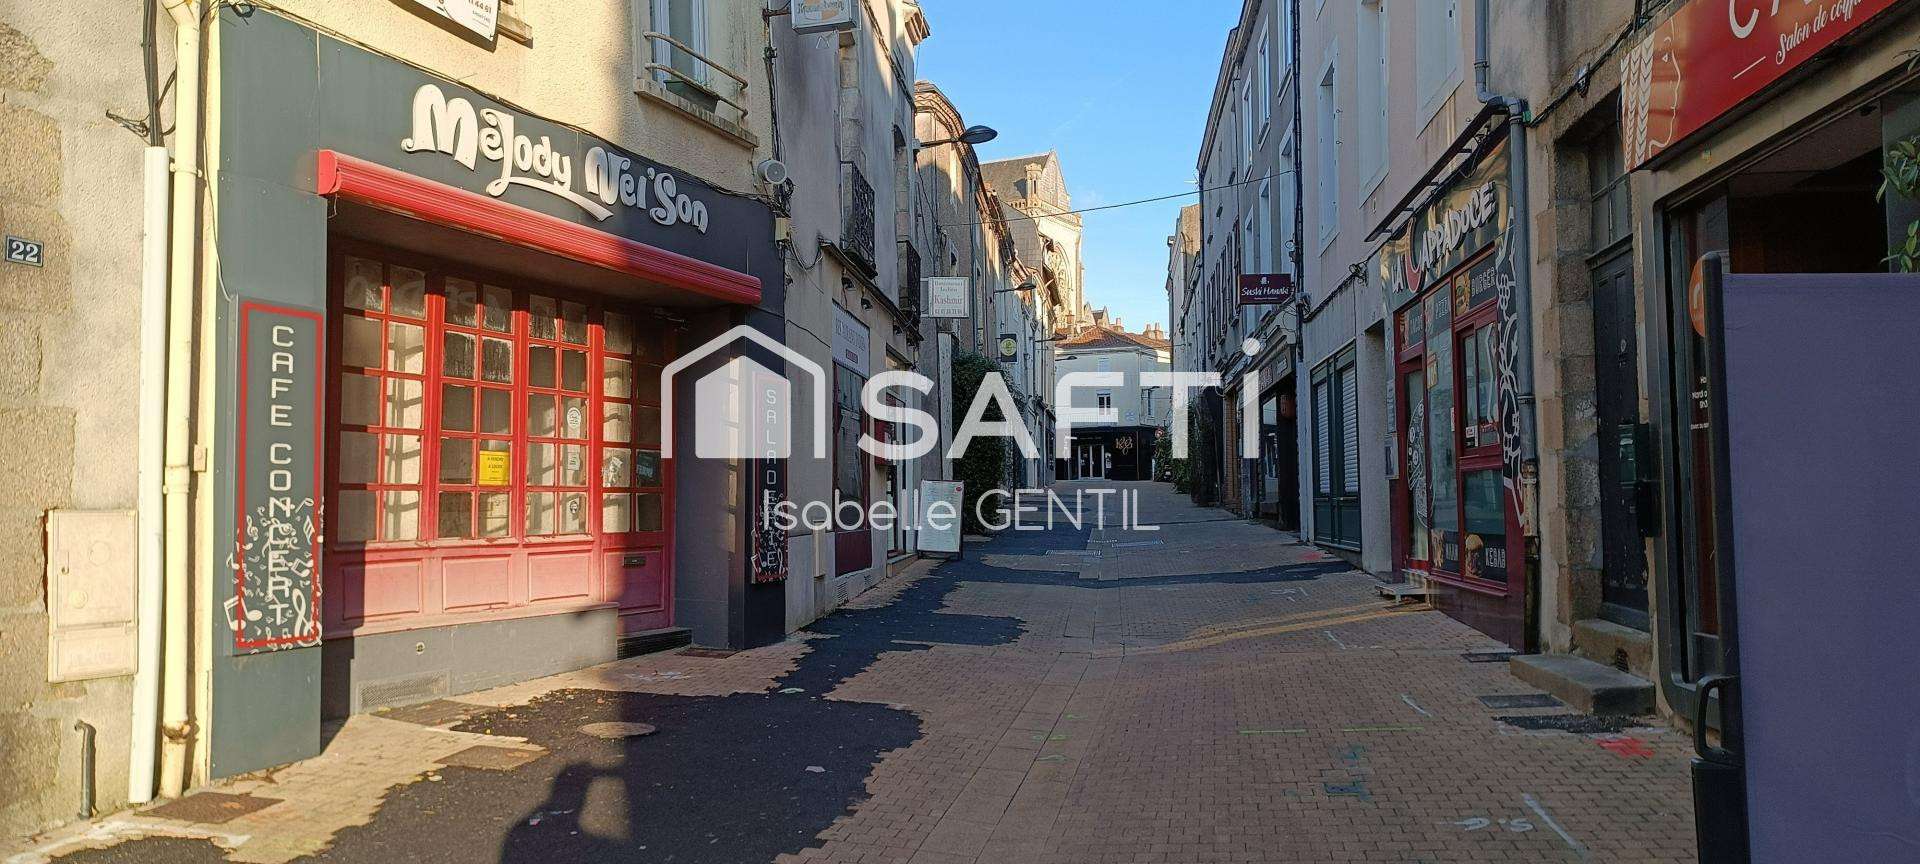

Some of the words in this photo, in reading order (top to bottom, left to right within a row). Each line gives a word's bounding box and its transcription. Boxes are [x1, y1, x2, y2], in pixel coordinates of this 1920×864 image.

[1776, 22, 1810, 65] Salon
[1813, 5, 1829, 33] de
[12, 241, 39, 263] 22
[1241, 286, 1262, 296] Sushi
[1392, 255, 1406, 294] LA
[1472, 267, 1497, 298] BURGER
[271, 324, 295, 427] CAFE
[268, 442, 295, 626] CONCERT
[1485, 546, 1507, 569] KEBAB
